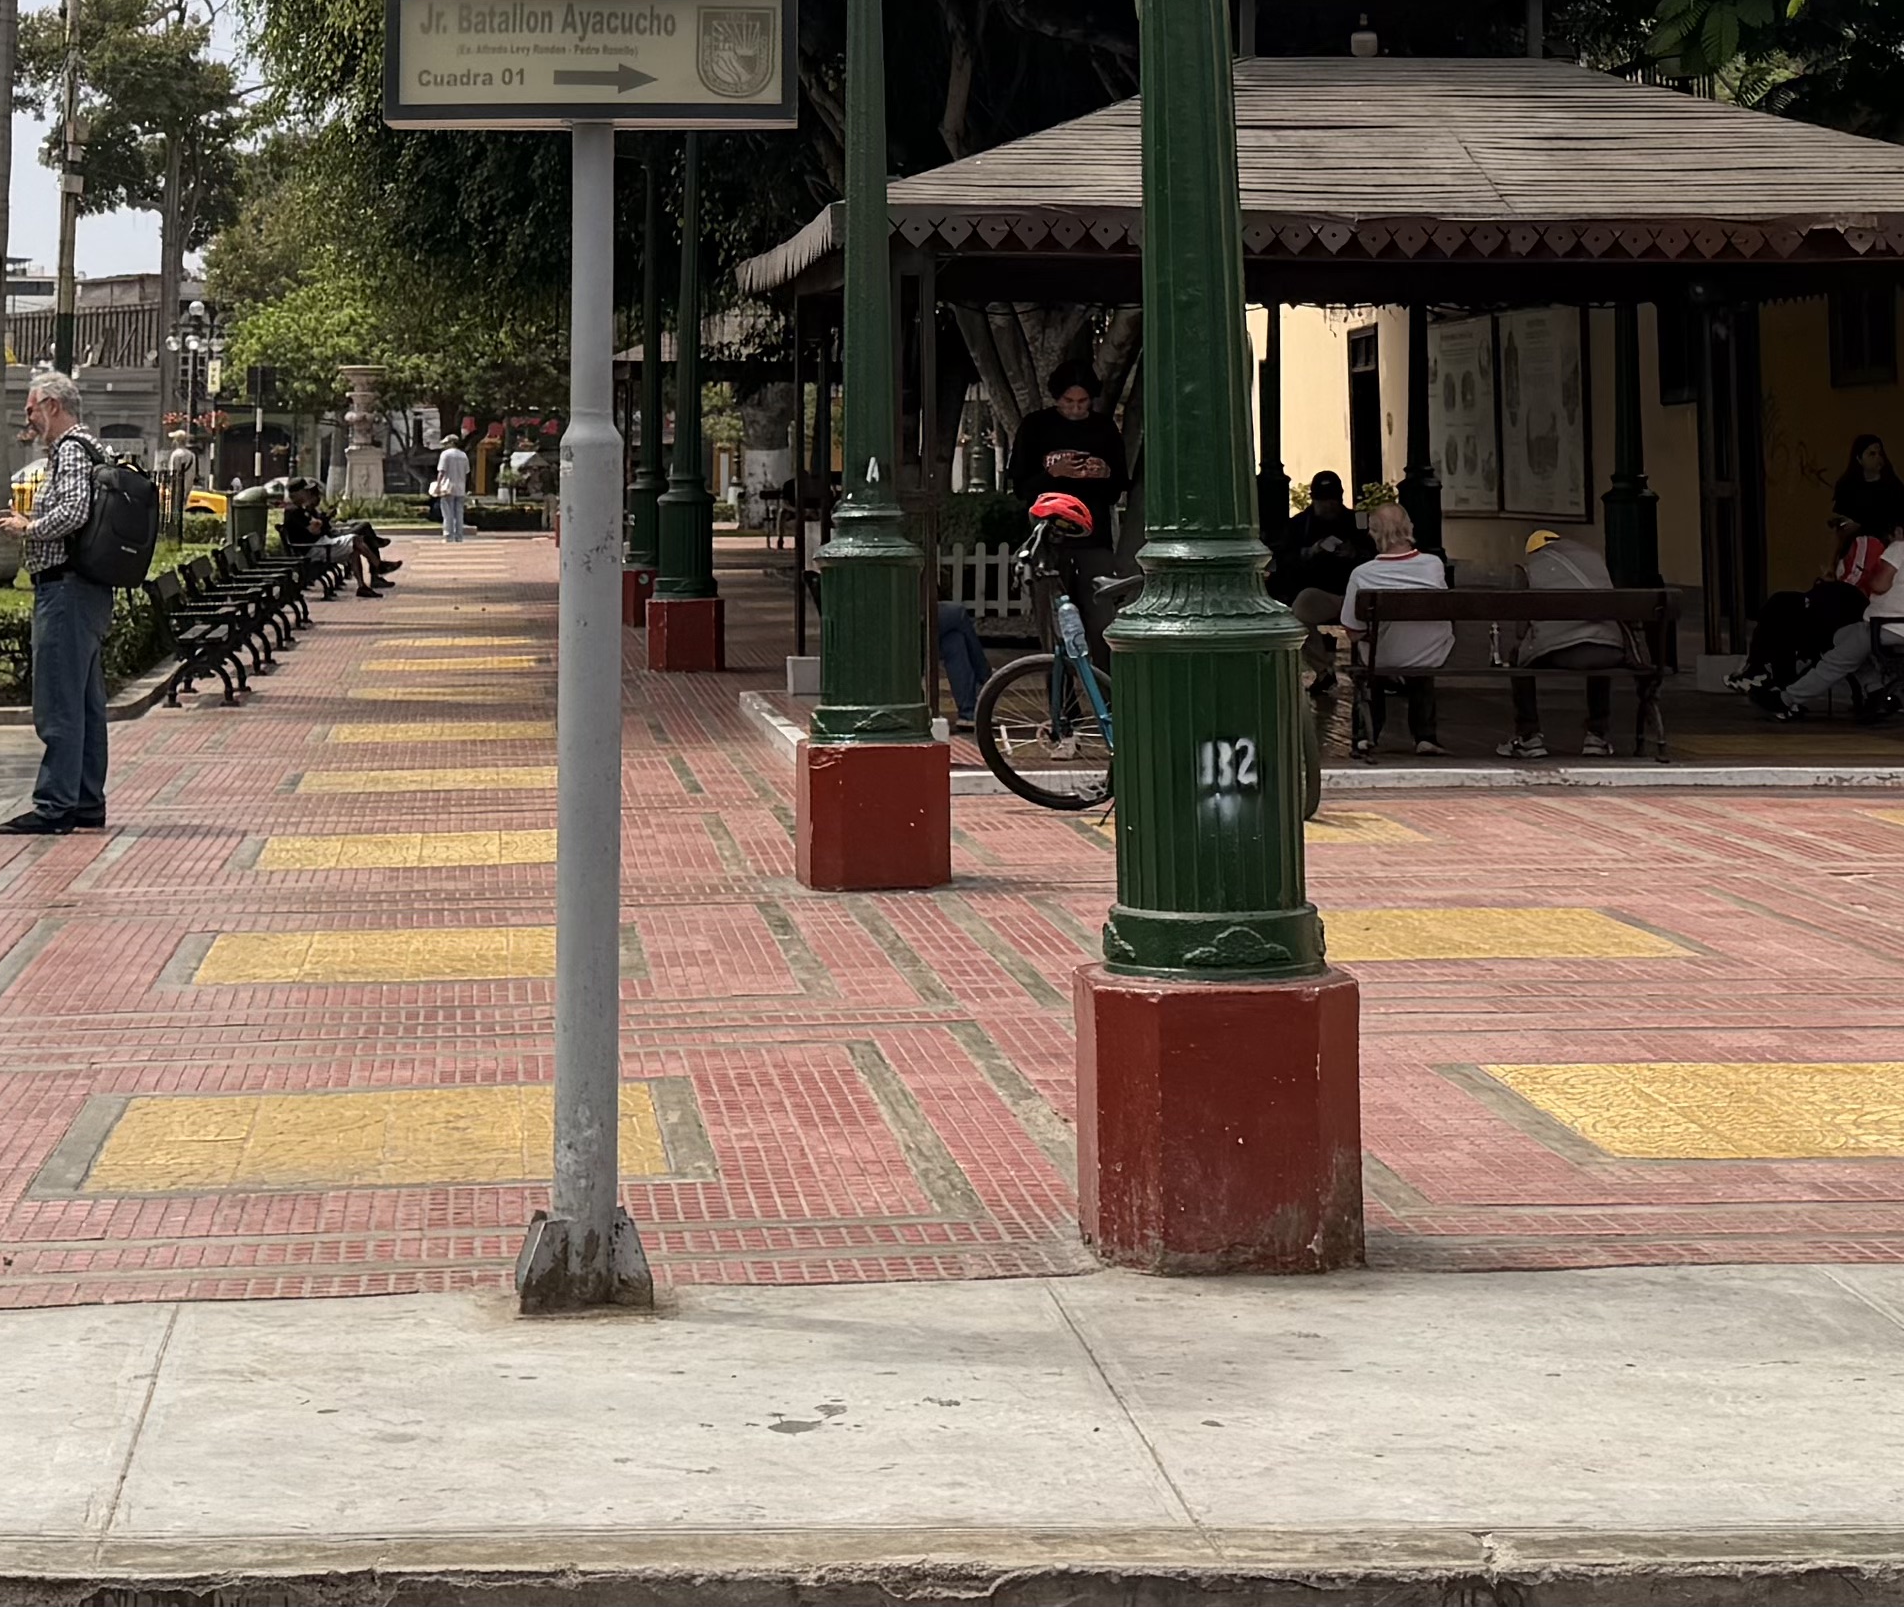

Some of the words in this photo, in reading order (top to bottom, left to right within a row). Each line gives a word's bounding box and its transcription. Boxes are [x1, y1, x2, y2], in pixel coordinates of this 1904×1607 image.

[420, 3, 447, 35] Jr.
[457, 2, 553, 35] Batallon
[561, 2, 677, 42] Ayacucho
[417, 69, 494, 87] Cuadra
[501, 68, 526, 86] 01
